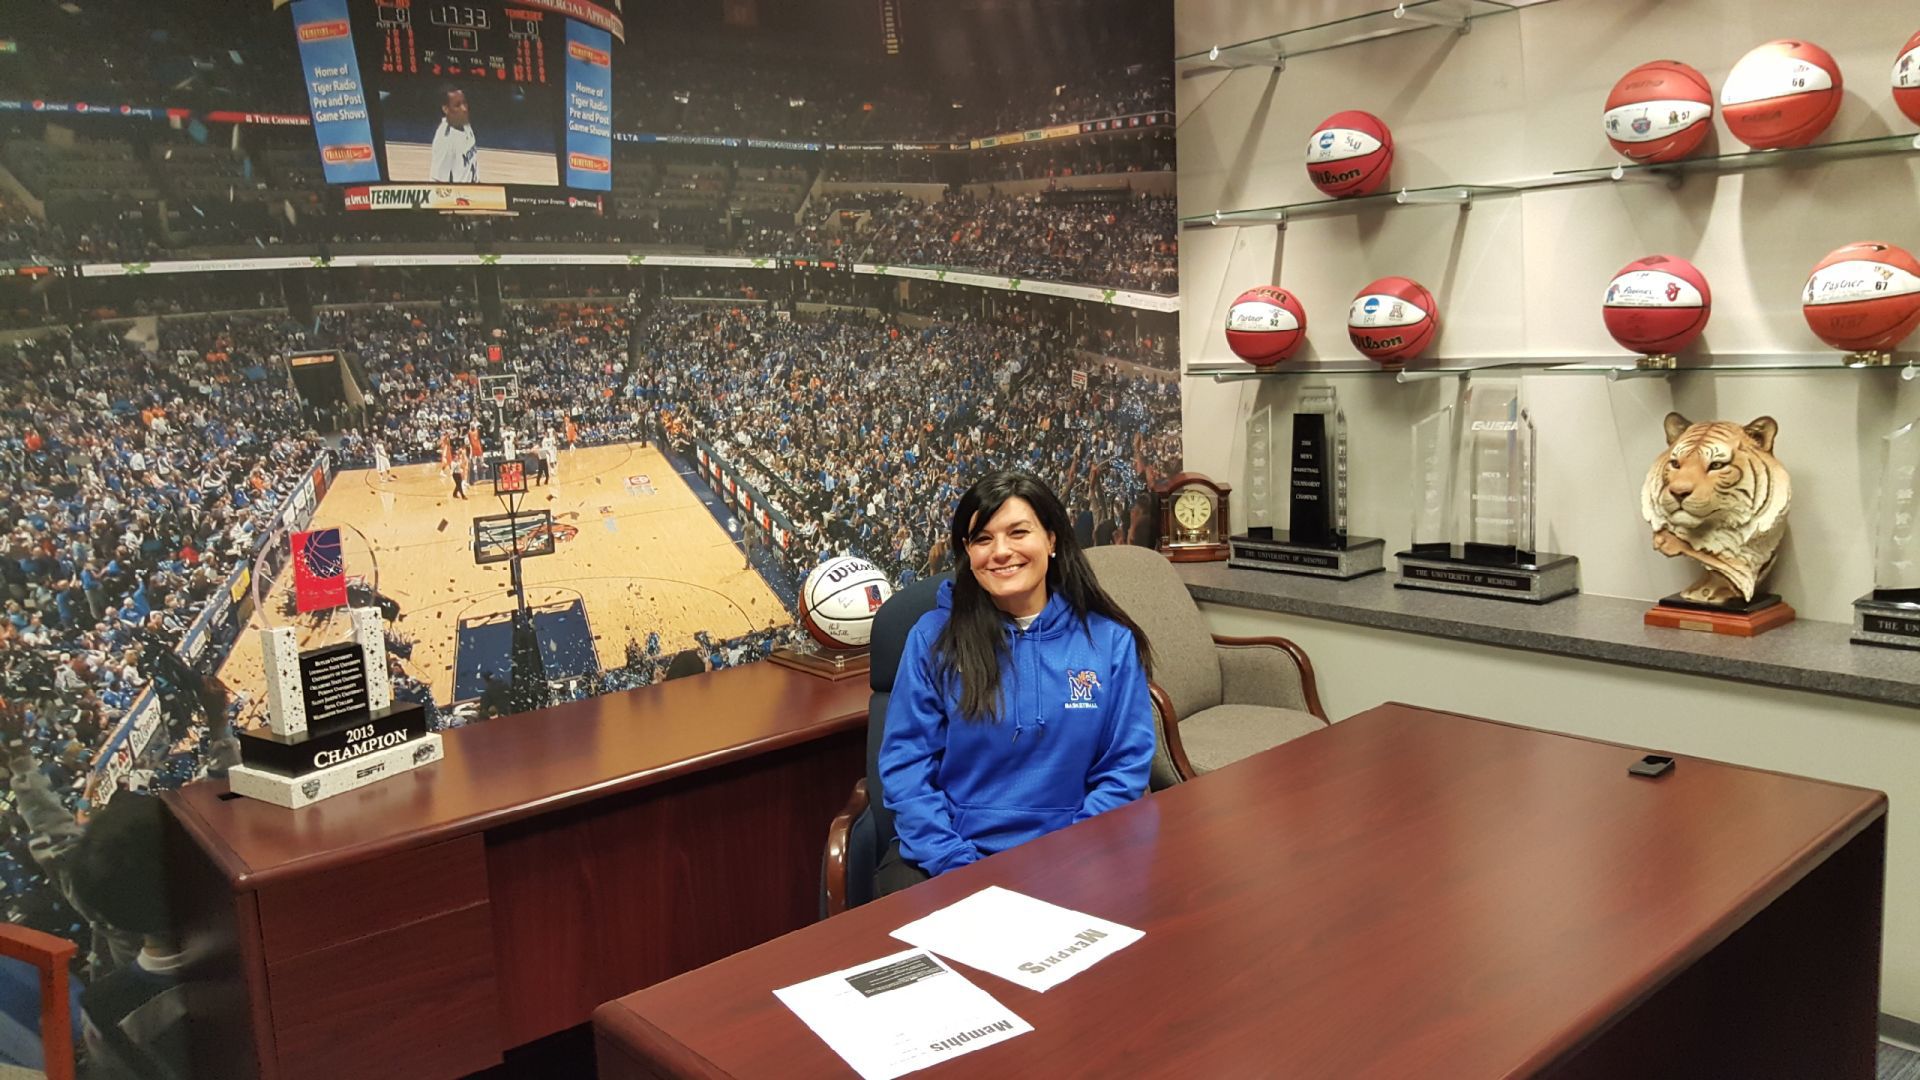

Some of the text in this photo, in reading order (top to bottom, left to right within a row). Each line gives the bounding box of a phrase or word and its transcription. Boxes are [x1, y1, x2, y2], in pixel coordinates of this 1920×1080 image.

[315, 64, 348, 78] Home of
[312, 80, 356, 95] Tiger Radio
[576, 81, 604, 97] Home of
[313, 94, 362, 108] Pre and Post
[571, 94, 608, 111] Tiger Radio
[316, 109, 366, 122] Game Shows
[569, 108, 609, 125] Pre and Post
[569, 120, 610, 137] Game Shows
[370, 189, 431, 204] TERMINIX
[1415, 569, 1428, 577] THE
[1878, 620, 1899, 630] THE
[346, 724, 375, 743] 2013
[313, 728, 408, 768] CHAMPION
[356, 763, 385, 779] ESPN
[1017, 928, 1109, 974] MEMPHIS
[929, 1019, 1014, 1052] Memphis
